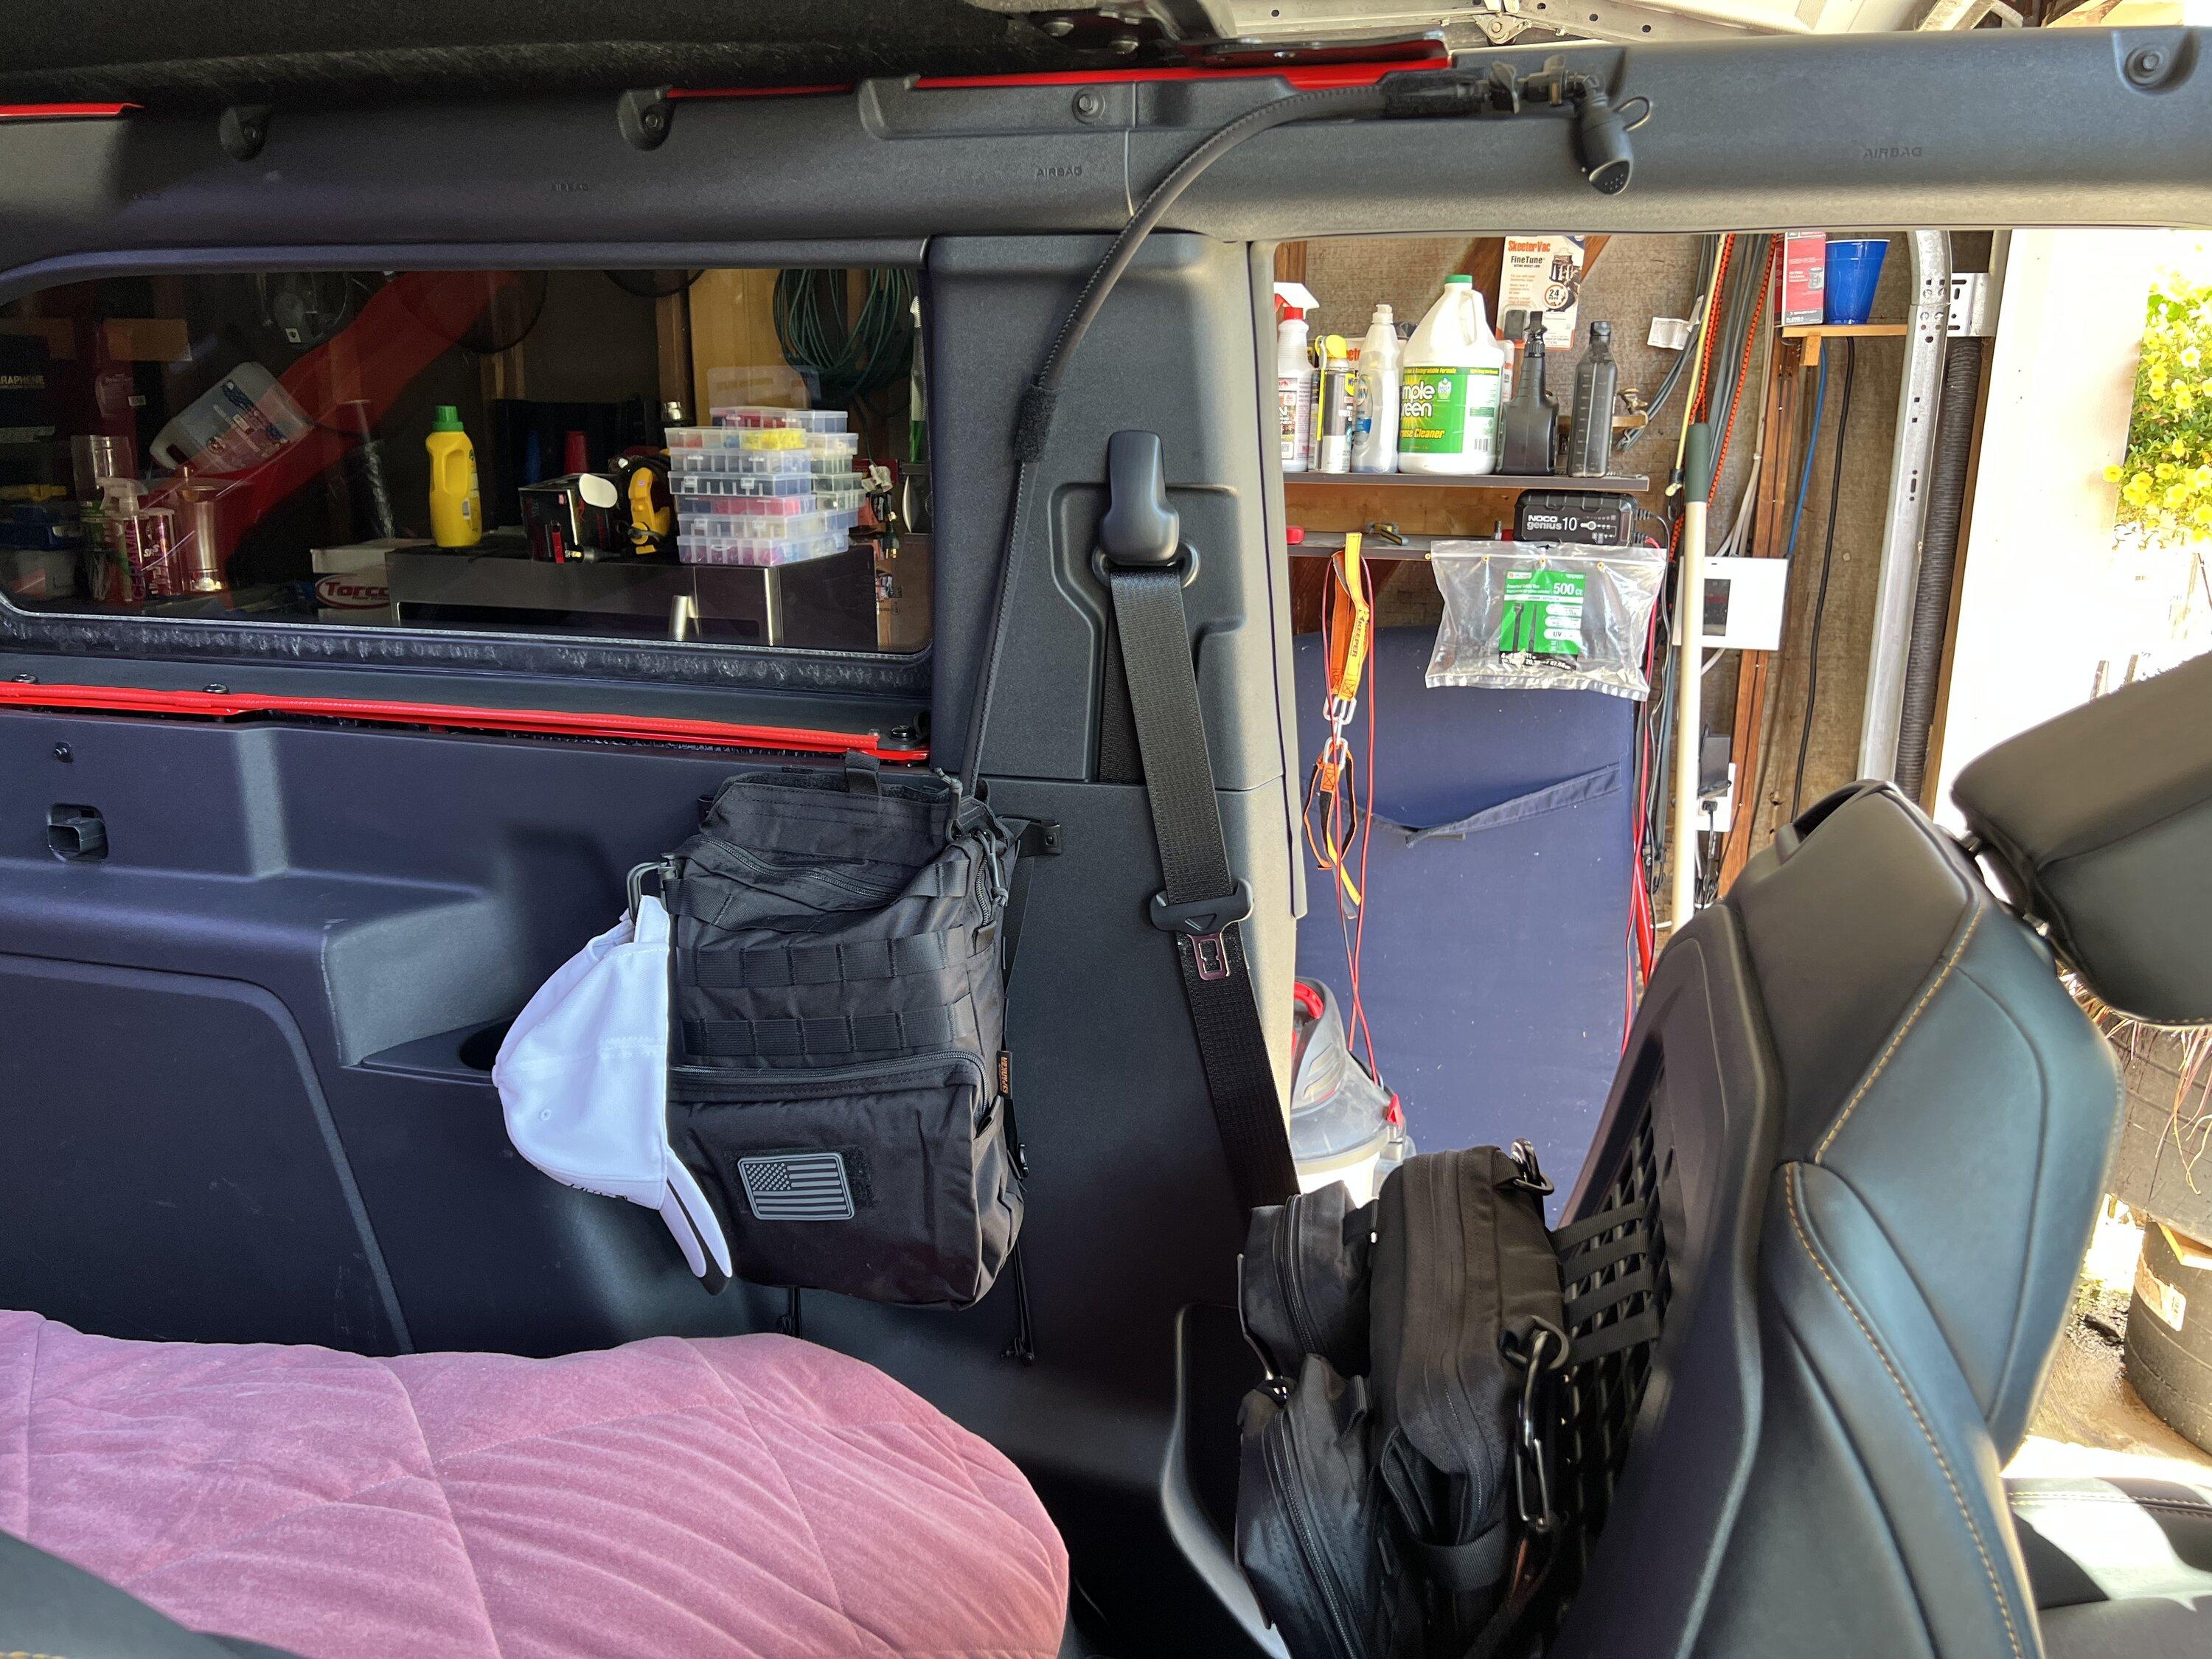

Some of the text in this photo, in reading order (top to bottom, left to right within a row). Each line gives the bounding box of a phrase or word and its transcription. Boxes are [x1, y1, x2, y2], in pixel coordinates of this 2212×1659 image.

[1863, 147, 1922, 159] AIRBAG
[1036, 166, 1082, 177] AIRBAG
[1511, 255, 1543, 264] FineTune
[1549, 289, 1559, 297] 24
[0, 375, 45, 385] RAPHENE
[1402, 380, 1436, 403] mple
[1402, 401, 1433, 417] reen
[1400, 428, 1445, 439] pose Cleaner
[1528, 515, 1559, 523] NOCO
[1553, 582, 1575, 595] 500
